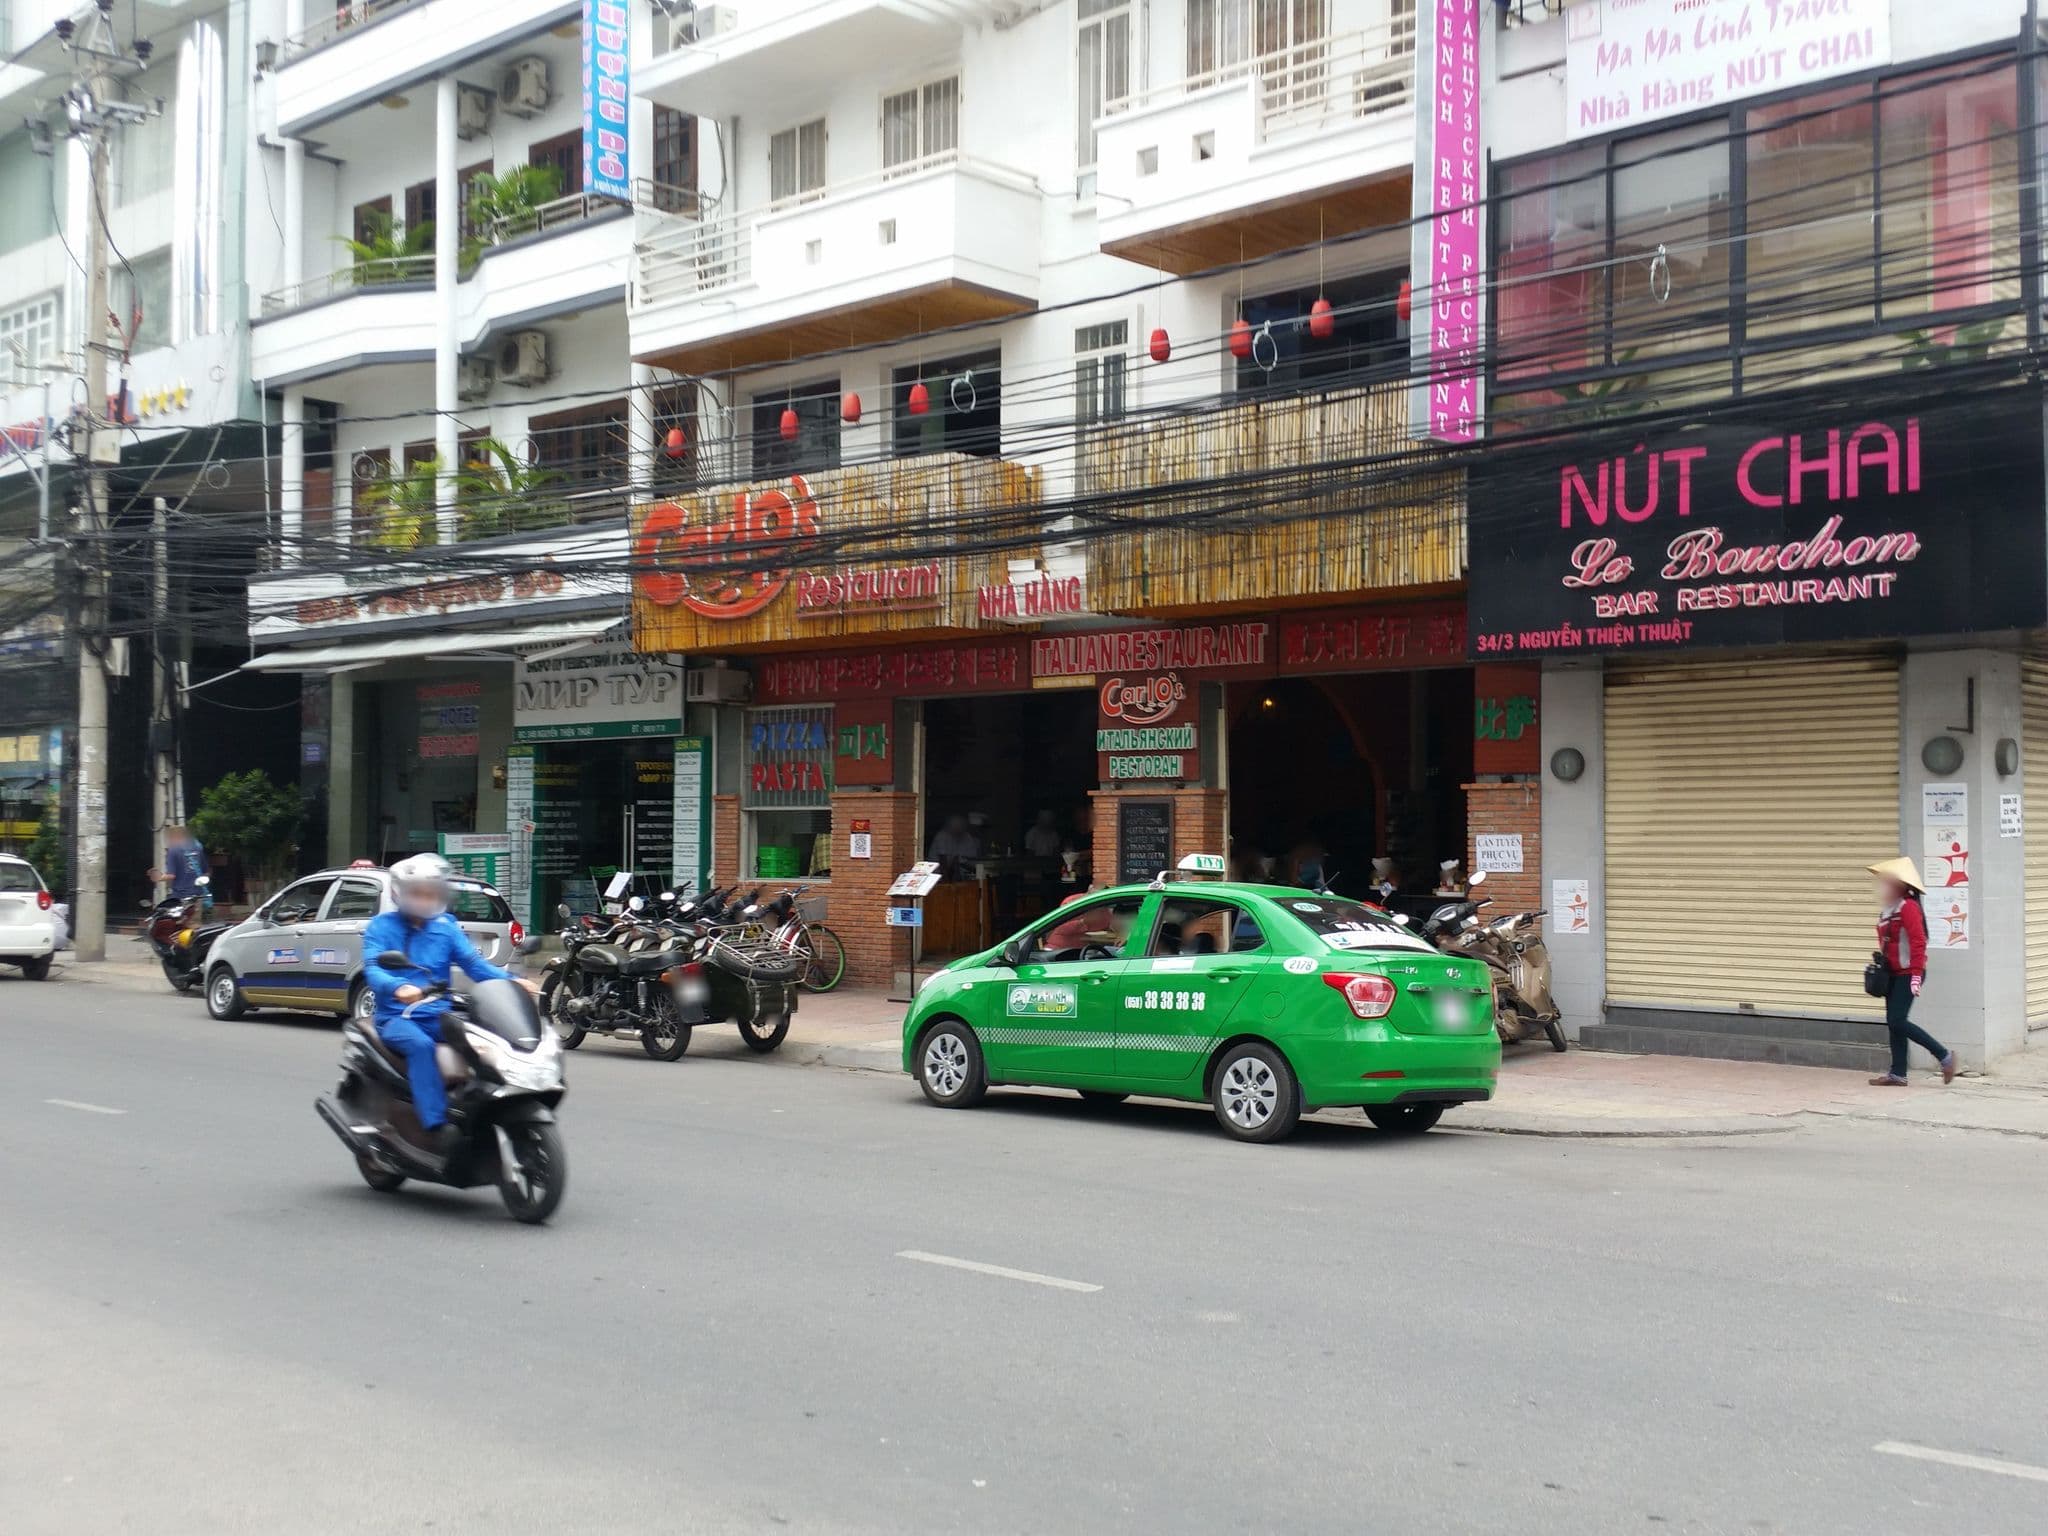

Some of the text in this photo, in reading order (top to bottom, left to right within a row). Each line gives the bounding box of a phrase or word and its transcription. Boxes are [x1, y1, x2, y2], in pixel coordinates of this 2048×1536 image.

[1596, 41, 1633, 77] Ma
[1644, 27, 1682, 64] Ma
[1693, 8, 1752, 50] Linh
[1580, 27, 1874, 128] Nhà Hàng NÚT CHAI
[1561, 417, 1921, 528] NÚT CHAI
[1562, 514, 1922, 588] Le Bouchon
[796, 559, 942, 608] Restaurant
[978, 572, 1082, 619] NHÀ HÀNG
[1591, 572, 1897, 618] BAR RESTAURANT
[1115, 622, 1268, 672] RESTAURANT
[1477, 632, 1514, 651] 34/3
[1519, 622, 1582, 648] NGUYỄN
[1586, 623, 1634, 649] THIỆN
[1638, 617, 1693, 643] THUẬT
[514, 677, 599, 711] МИР
[605, 671, 678, 705] ТУР
[751, 722, 828, 752] PIZZA
[838, 723, 889, 761] 피자
[1096, 722, 1197, 752] ИТАЛЬЯНСКИЙ
[752, 761, 827, 792] PASTA
[1109, 755, 1184, 778] РЕСТОРАН
[1289, 960, 1313, 971] 2178
[1145, 991, 1158, 1009] 38
[1160, 991, 1173, 1010] 38
[1176, 991, 1189, 1010] 38
[1192, 992, 1205, 1011] 38
